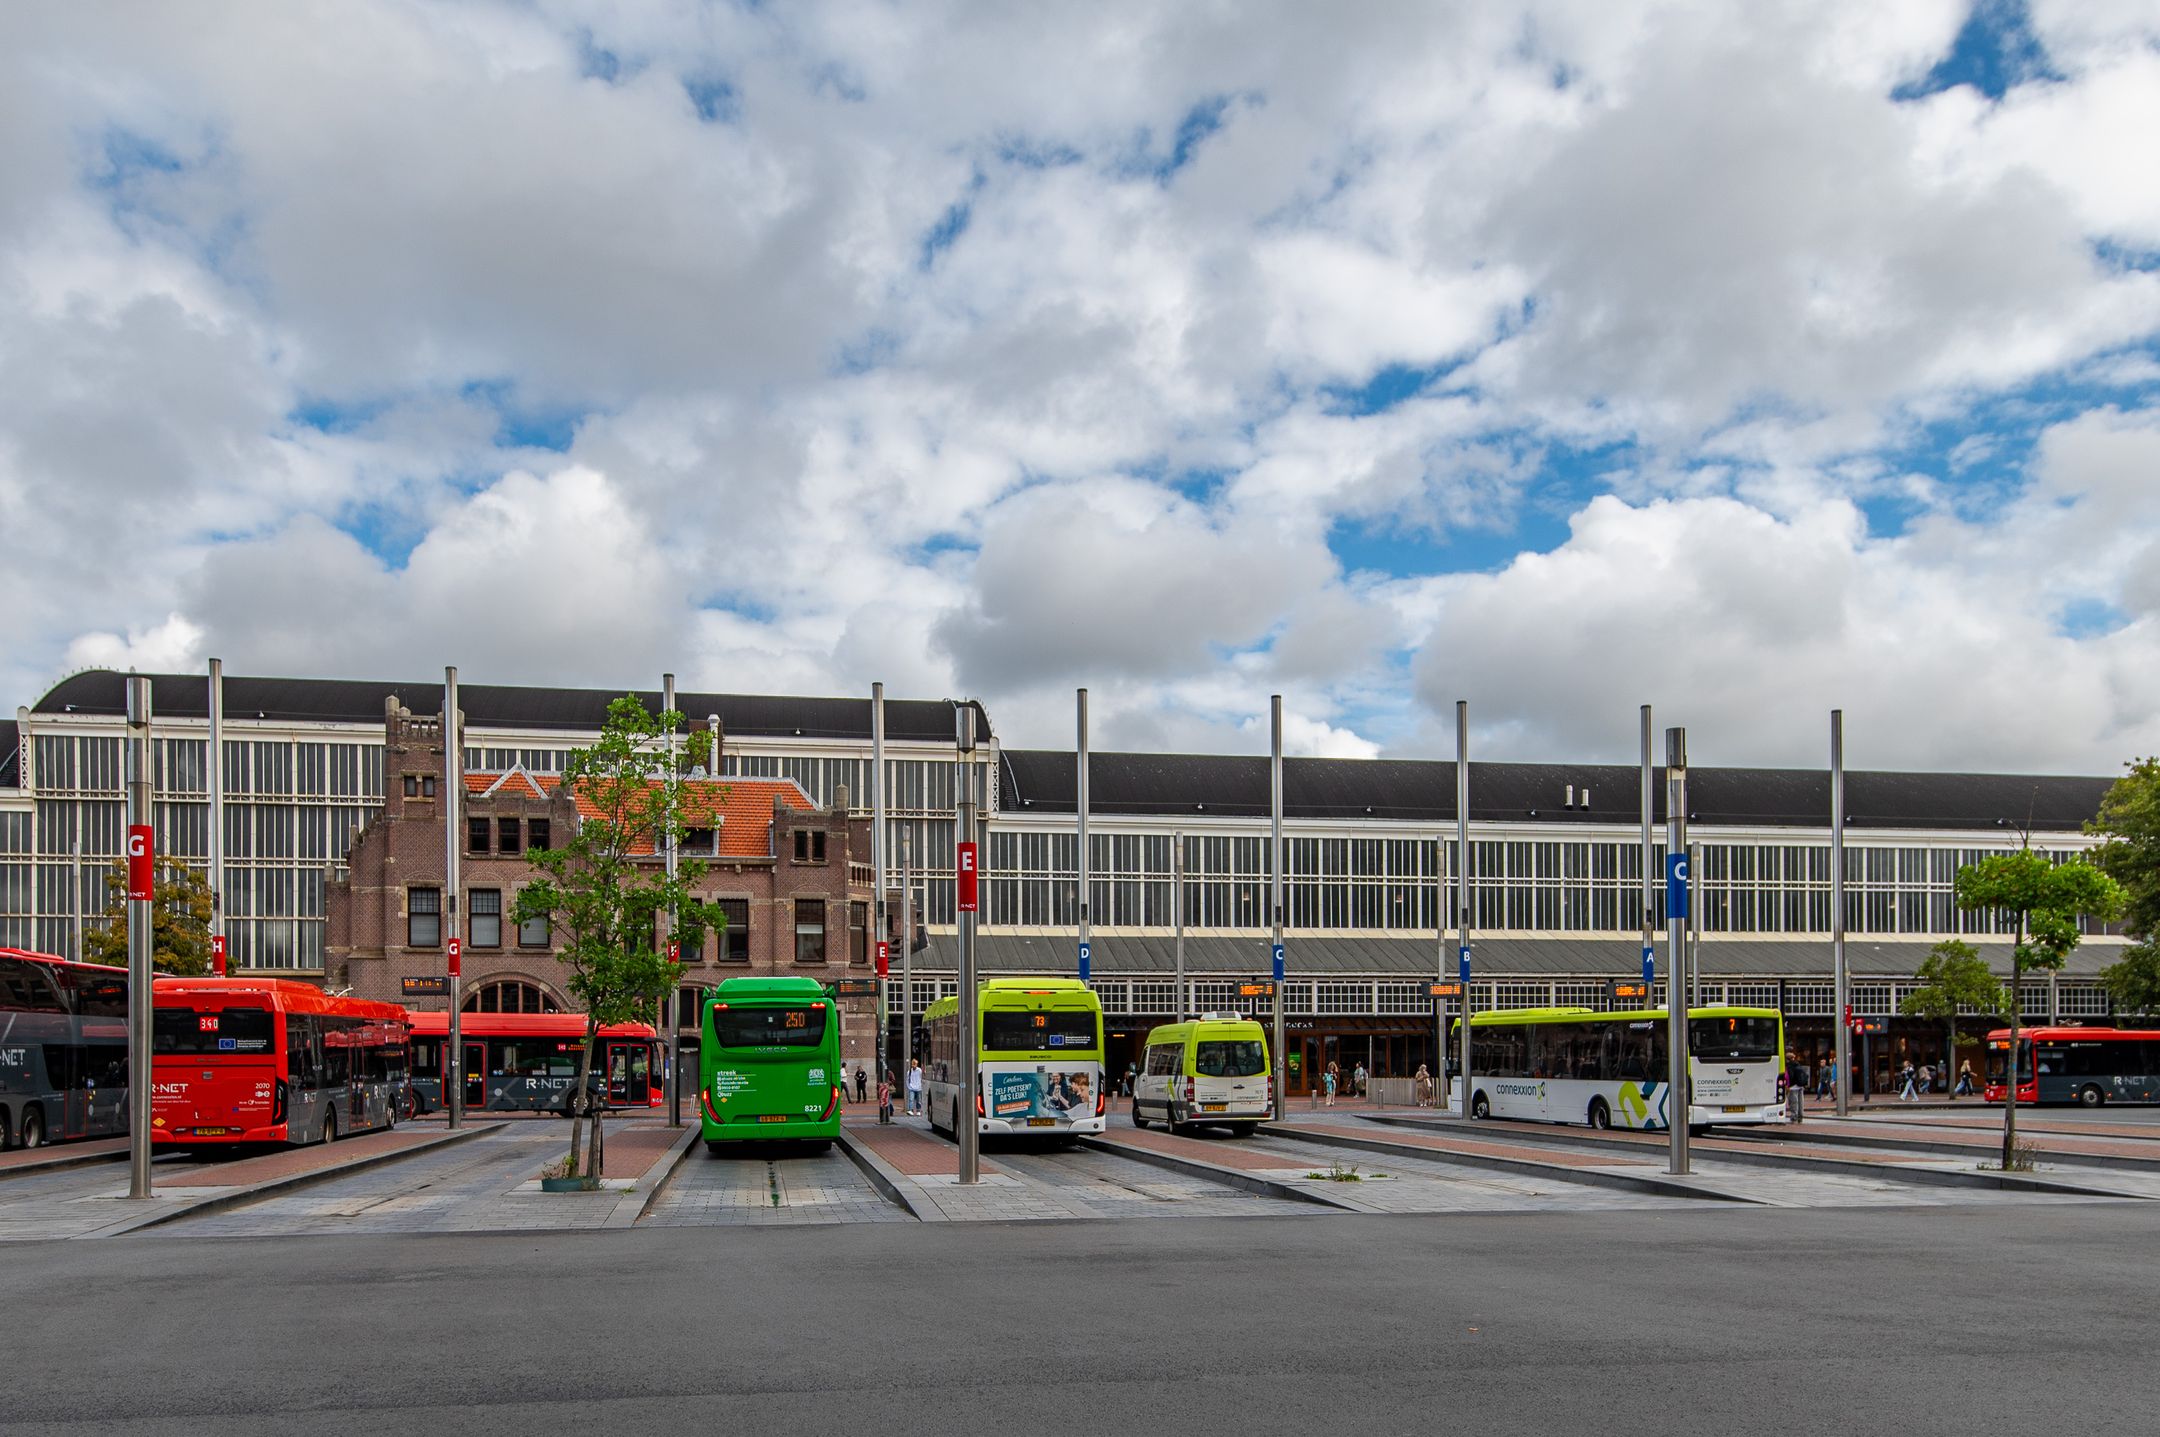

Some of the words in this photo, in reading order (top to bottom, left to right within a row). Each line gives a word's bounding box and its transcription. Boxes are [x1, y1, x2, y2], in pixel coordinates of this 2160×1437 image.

[129, 835, 145, 857] G
[962, 851, 973, 871] E
[1674, 861, 1687, 881] C
[213, 941, 222, 953] H
[449, 943, 458, 955] G
[879, 946, 886, 958] E
[1080, 947, 1090, 959] D
[1275, 949, 1283, 960] C
[1463, 951, 1471, 962] B
[1646, 952, 1654, 963] A
[201, 1018, 218, 1029] 340
[786, 1012, 806, 1028] 250
[1034, 1015, 1045, 1027] 73
[1264, 1021, 1313, 1029] STBUCKS
[1729, 1018, 1736, 1031] 7
[995, 1087, 1007, 1096] ZELF
[1007, 1083, 1032, 1094] POETSEN?
[1496, 1084, 1537, 1097] connexxion
[1012, 1091, 1028, 1101] LEUK!
[804, 1104, 822, 1112] 8221
